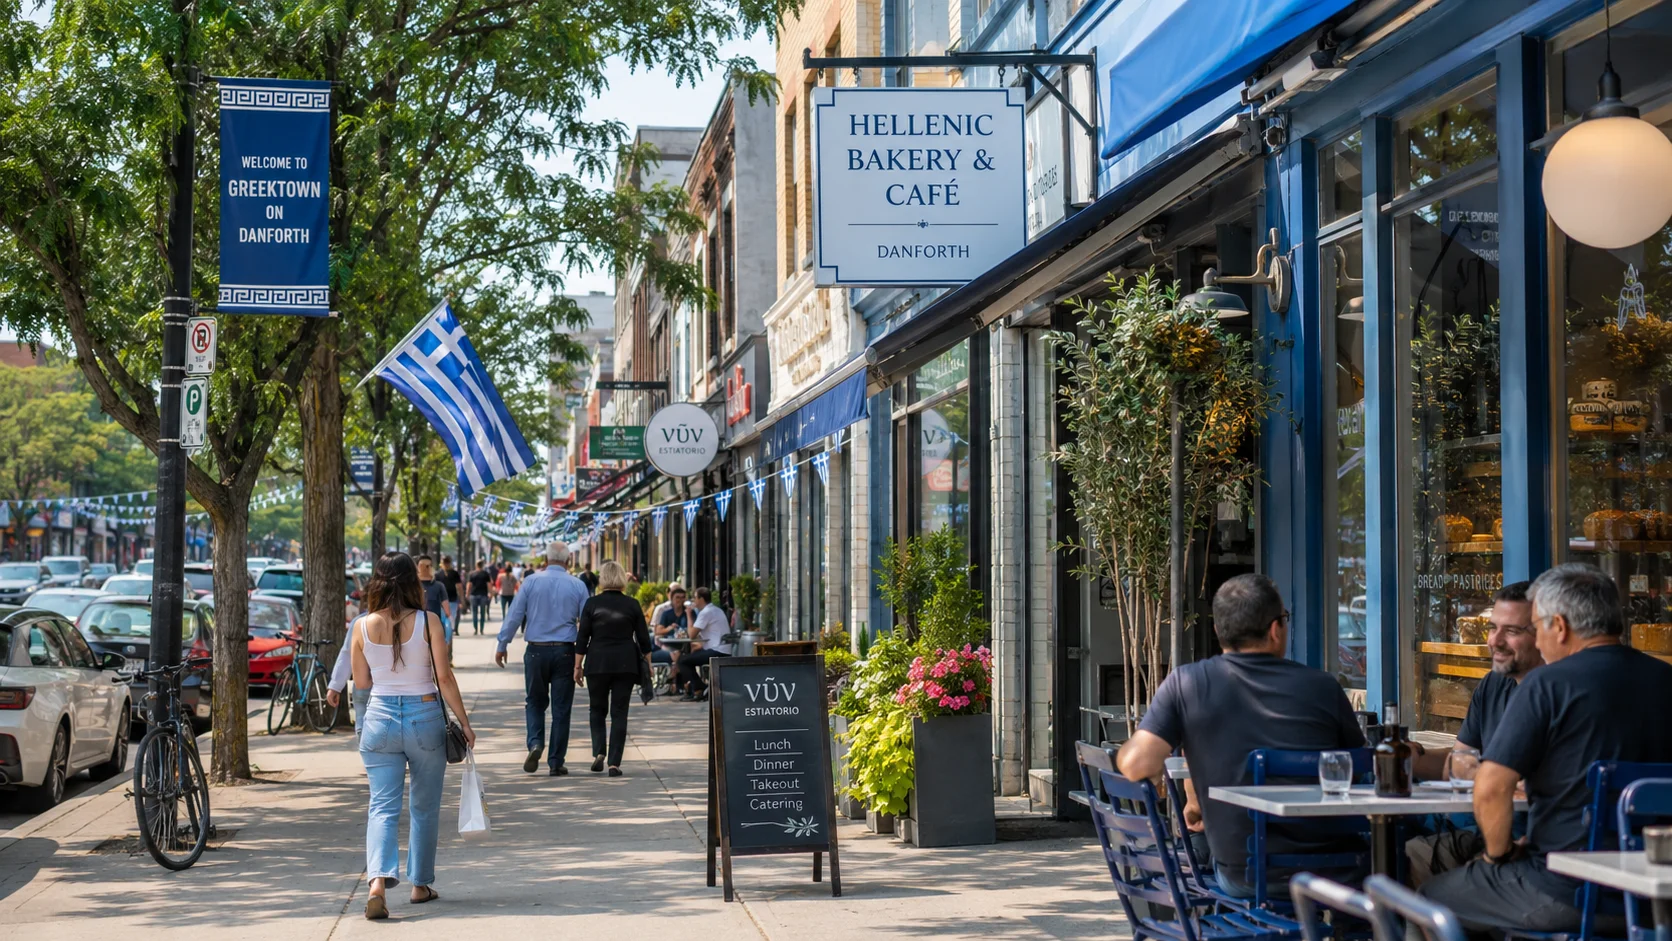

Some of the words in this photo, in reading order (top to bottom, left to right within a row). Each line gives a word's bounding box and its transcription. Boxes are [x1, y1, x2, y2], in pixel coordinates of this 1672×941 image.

[849, 114, 994, 136] HELLENIC
[241, 156, 292, 169] WELCOME
[294, 157, 308, 169] TO
[847, 148, 963, 171] BAKERY
[973, 148, 996, 171] &
[228, 179, 321, 198] GREEKTOWN
[885, 178, 960, 206] CAFÉ
[265, 204, 284, 220] ON
[239, 227, 310, 244] DANFORTH
[877, 245, 970, 259] DANFORTH
[659, 447, 706, 455] ESTIATORIO
[1417, 574, 1444, 589] BREAD
[744, 706, 800, 717] ESTIATORIO
[754, 738, 791, 751] Lunch
[753, 759, 795, 771] Dinner
[751, 778, 800, 790] Takeout
[749, 797, 803, 811] Catering
